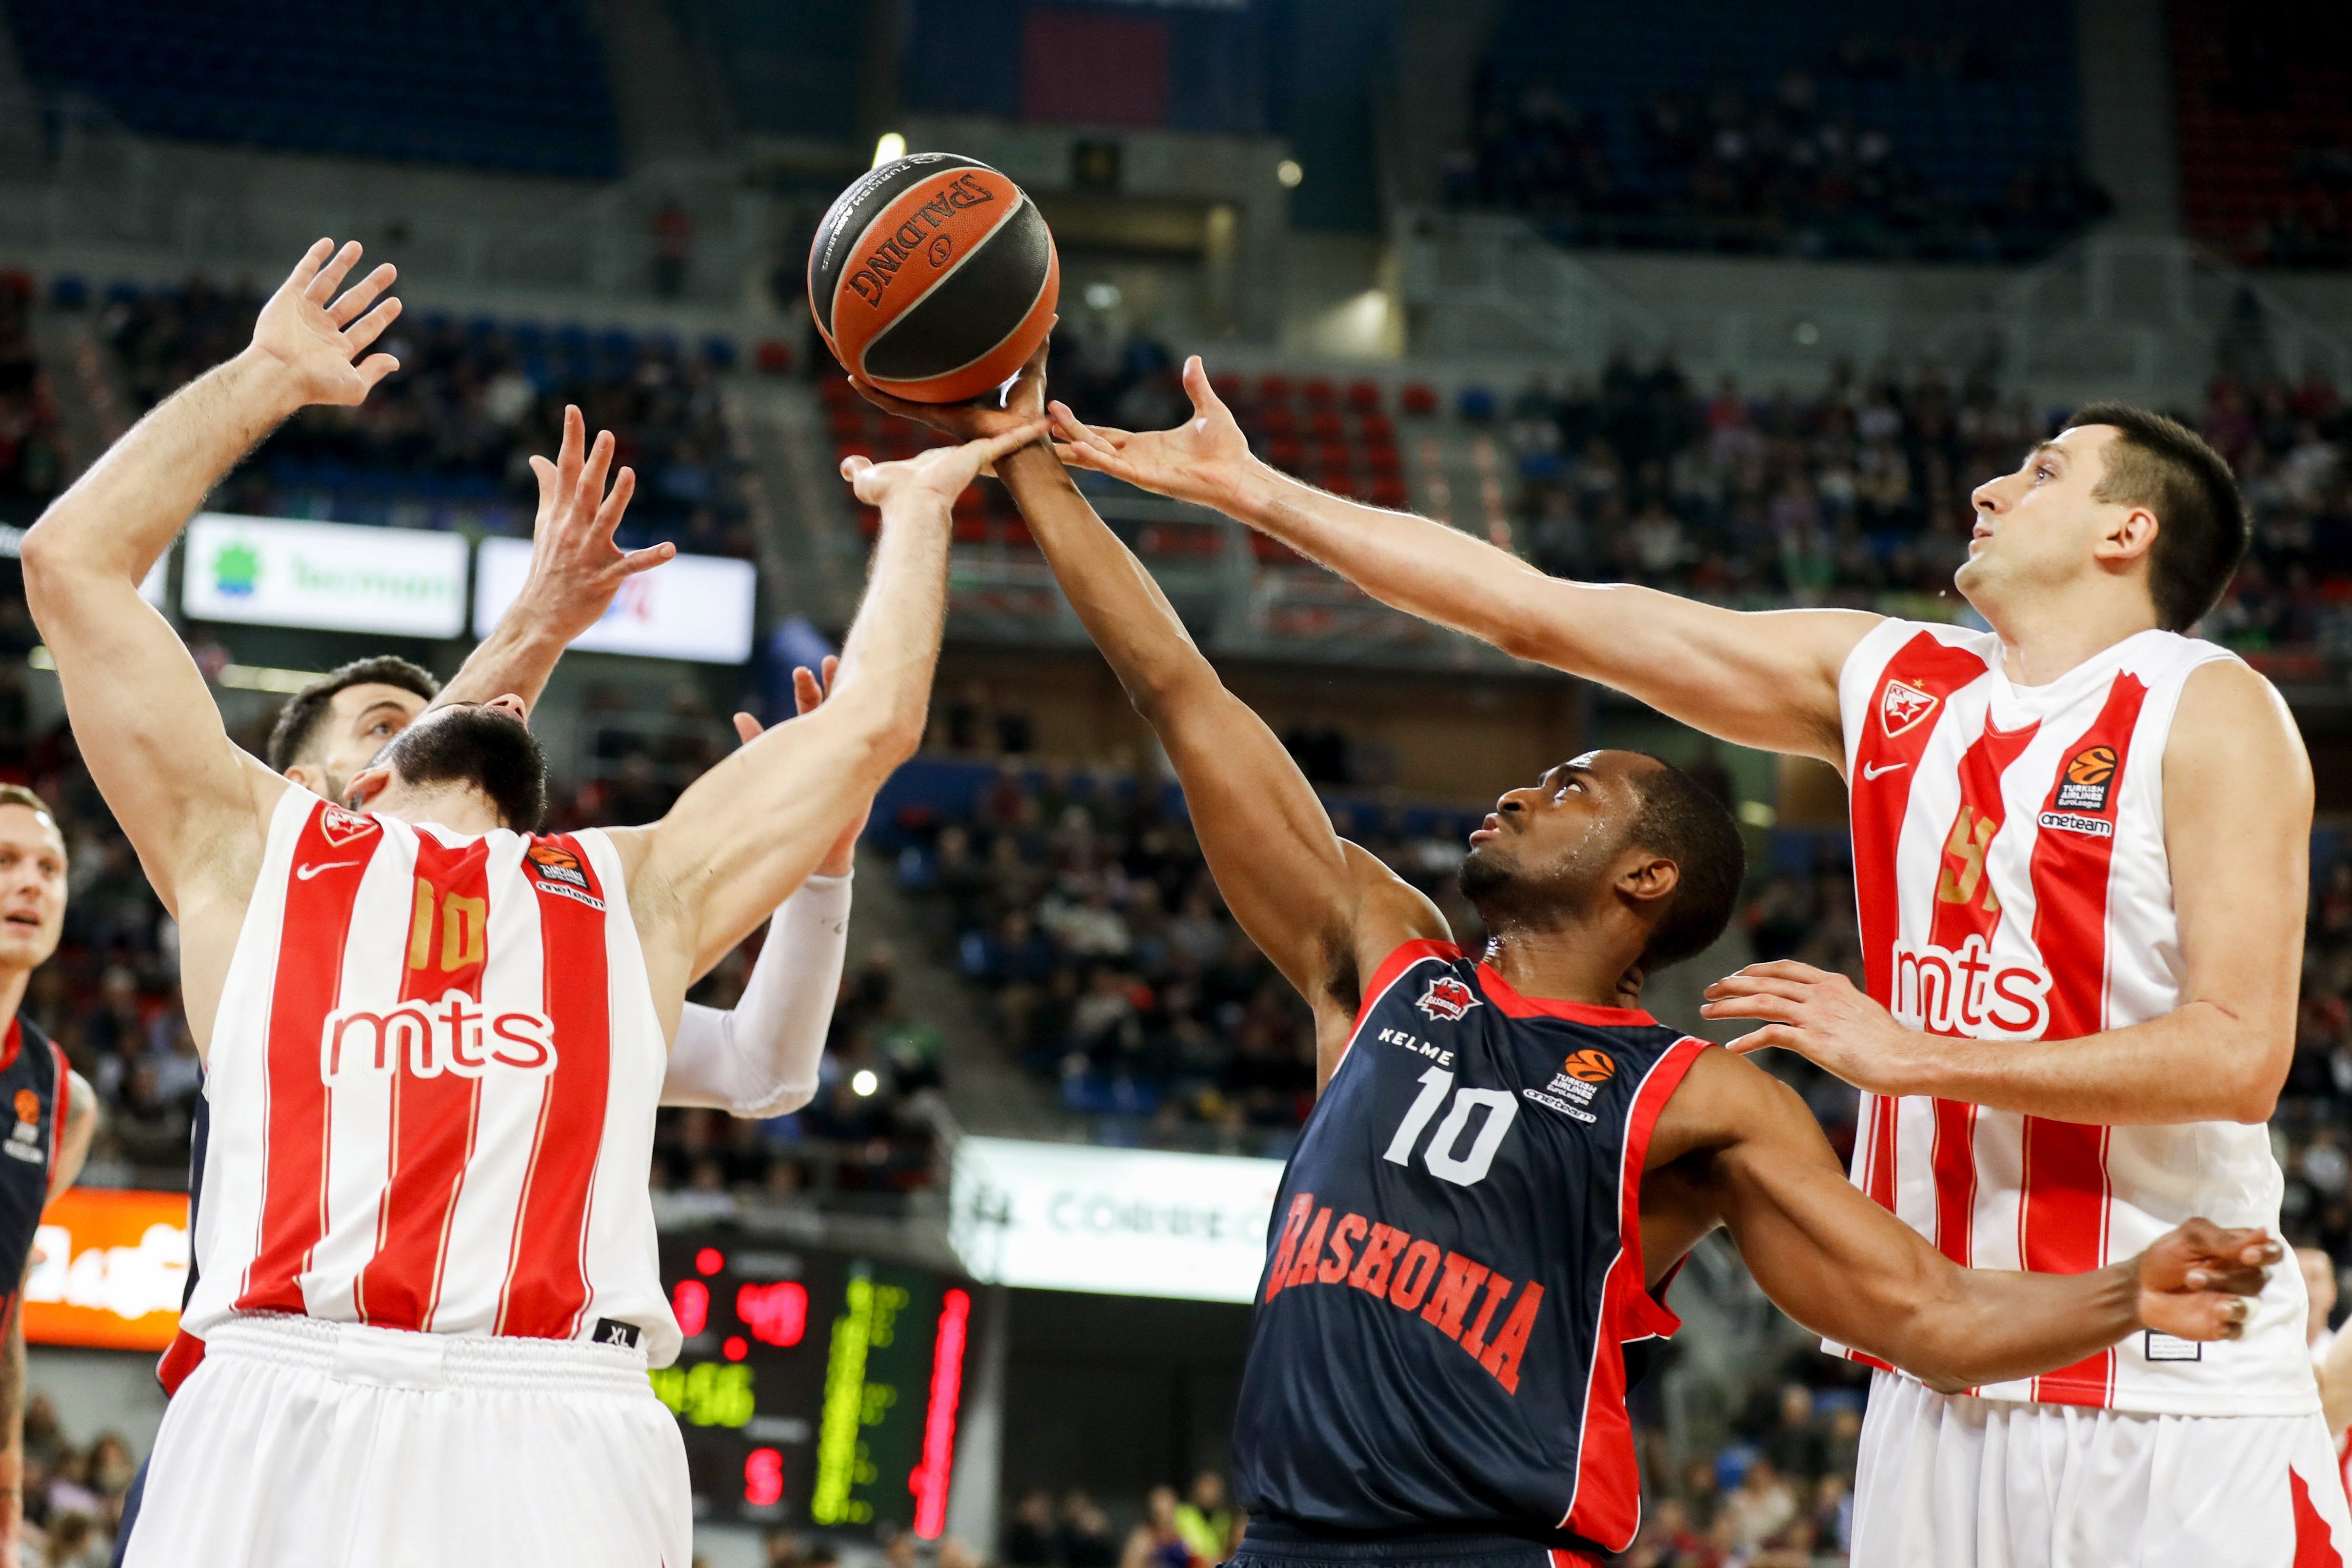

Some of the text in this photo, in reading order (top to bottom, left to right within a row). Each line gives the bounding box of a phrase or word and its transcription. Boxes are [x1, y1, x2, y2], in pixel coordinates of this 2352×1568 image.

[853, 164, 910, 207] TURKISH
[848, 173, 994, 309] SPALDING
[2060, 791, 2103, 801] AIRLINES
[2063, 784, 2105, 794] TURKISH
[2041, 814, 2111, 834] oneteam
[538, 883, 604, 909] oneteam
[408, 877, 487, 973] 10
[1895, 941, 2043, 1035] mts
[328, 998, 551, 1077] mts
[1378, 1028, 1455, 1067] KELME
[1550, 1078, 1594, 1100] AIRLINES
[1556, 1072, 1598, 1094] TURKISH
[1382, 1065, 1519, 1187] 10
[1265, 1192, 1546, 1397] BASKONIA
[605, 1325, 630, 1348] XL
